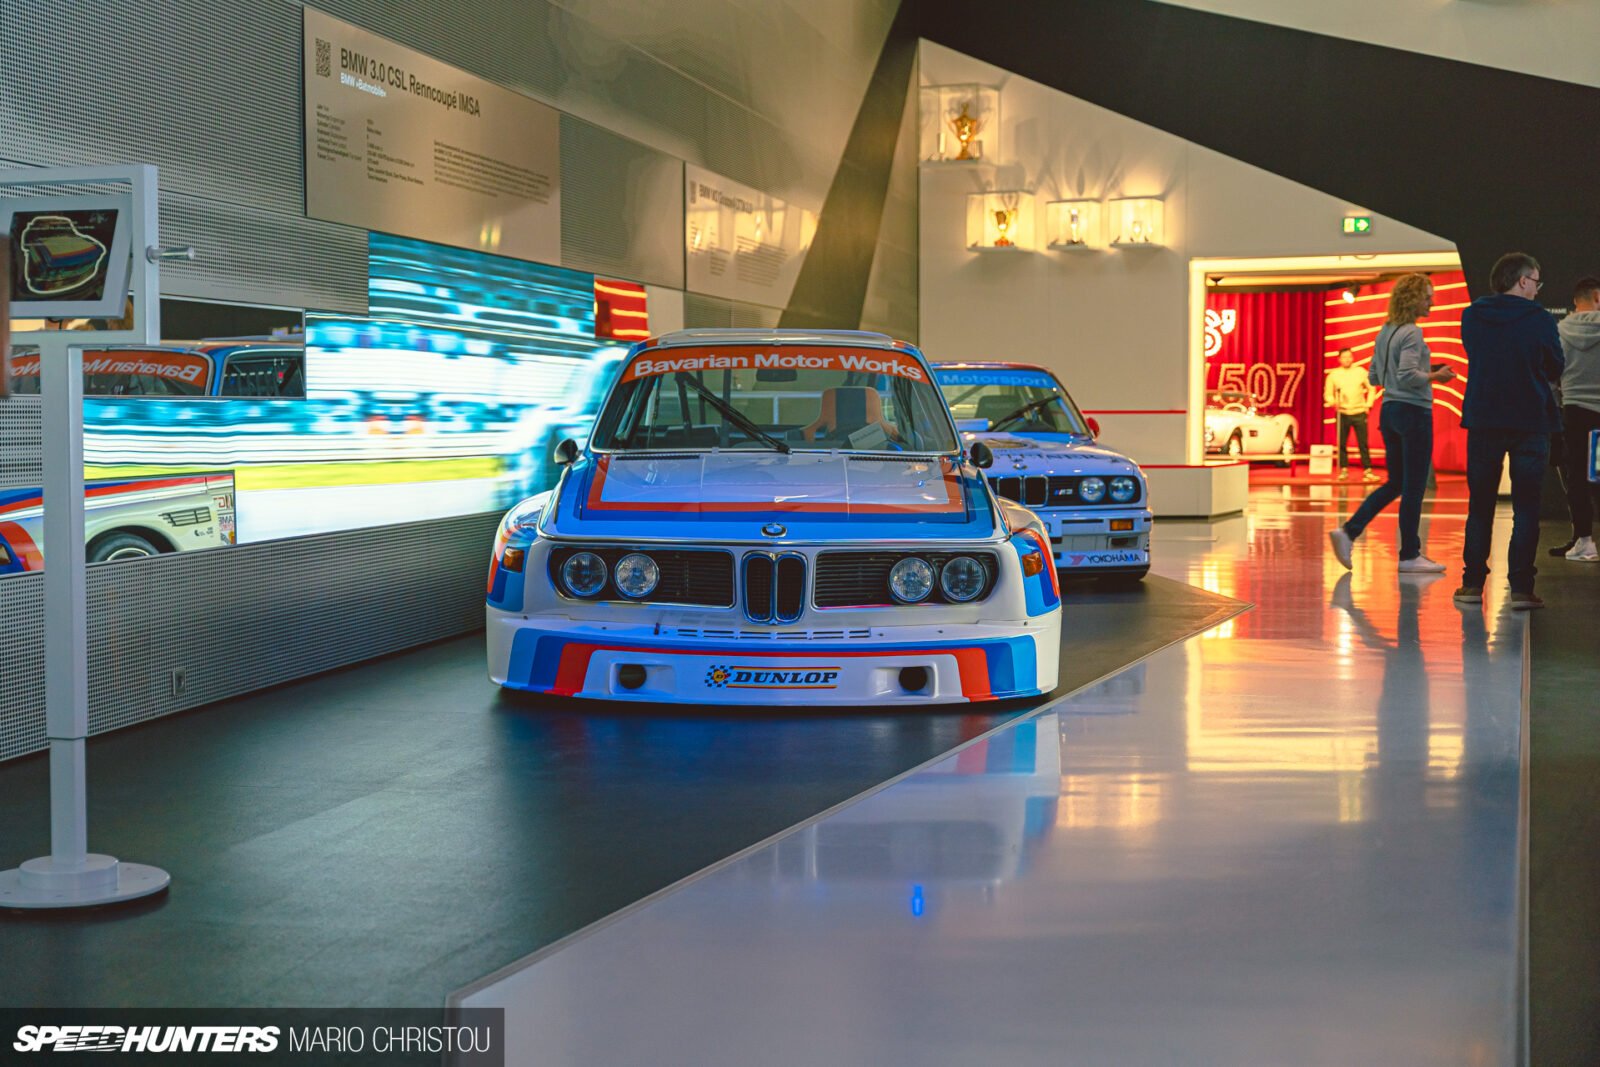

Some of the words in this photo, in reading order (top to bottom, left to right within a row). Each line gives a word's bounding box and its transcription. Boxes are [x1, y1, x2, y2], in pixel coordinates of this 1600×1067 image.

[341, 48, 368, 76] BMW
[370, 60, 385, 82] 3.0
[387, 66, 407, 91] CSL
[409, 74, 457, 111] Renncoupé
[459, 93, 481, 117] IMSA
[634, 354, 748, 377] Bavarian
[754, 353, 834, 368] Motor
[839, 355, 922, 379] Works
[943, 374, 1049, 387] Motorsport
[1218, 363, 1305, 407] 507
[1086, 554, 1141, 564] YOKOHAMA
[733, 672, 838, 683] DUNLOP
